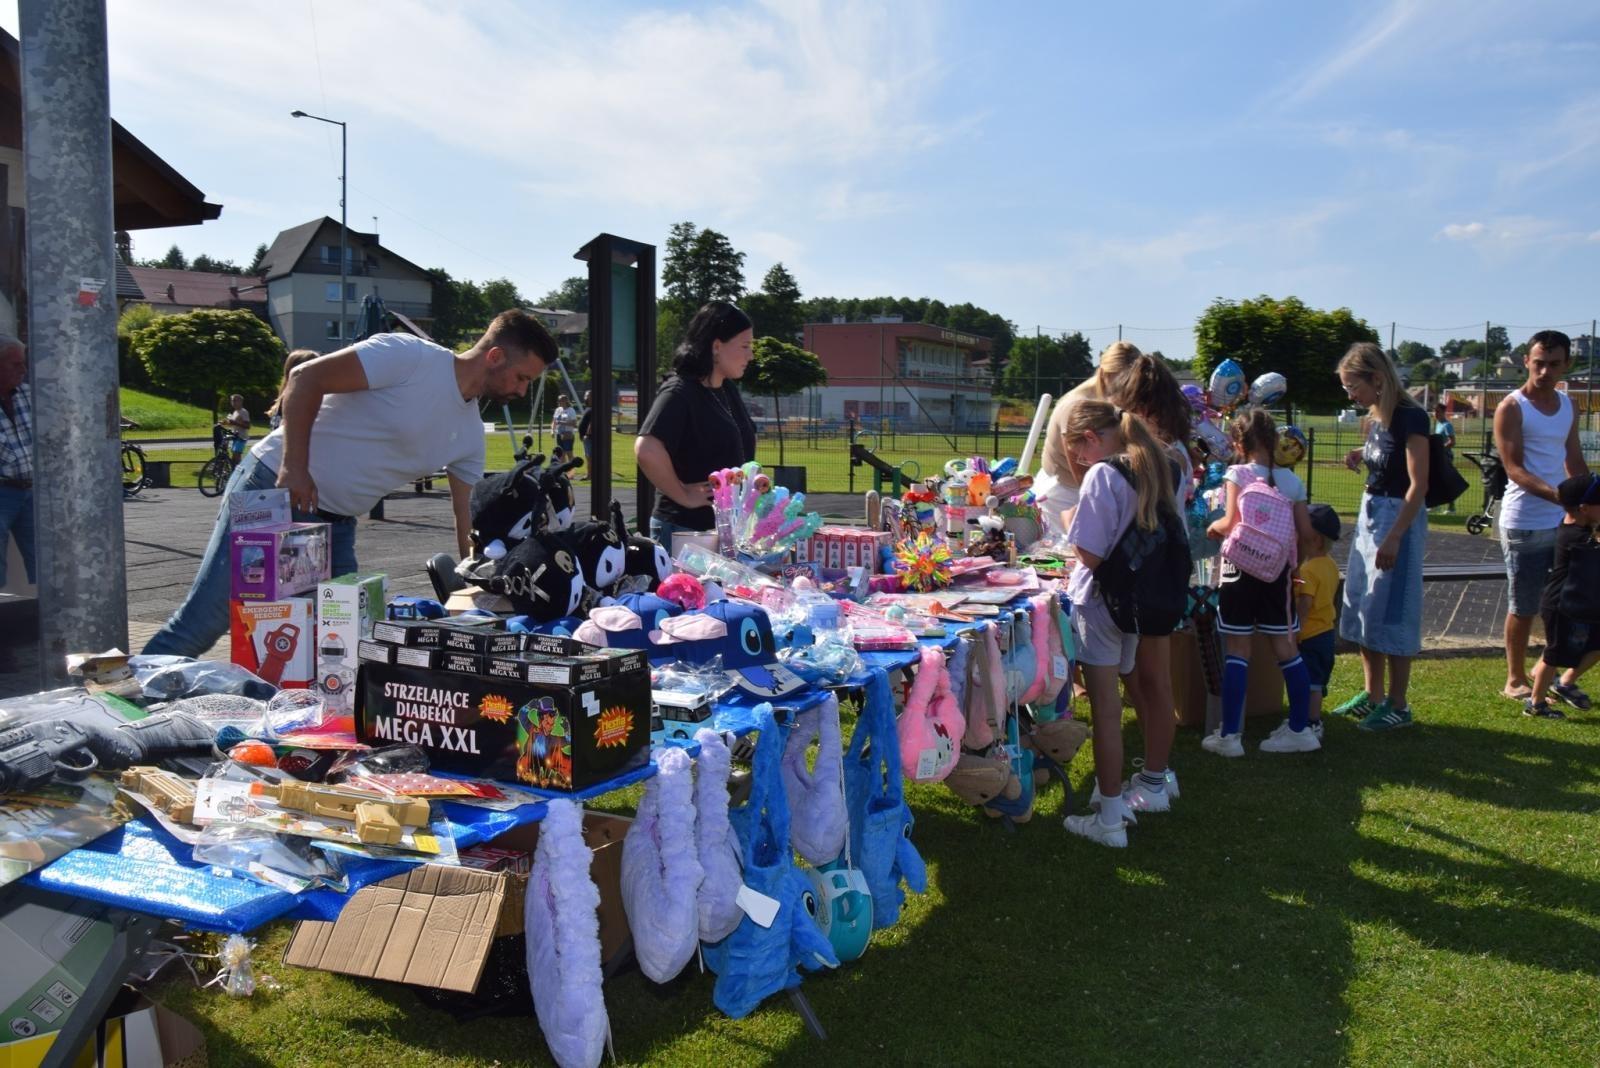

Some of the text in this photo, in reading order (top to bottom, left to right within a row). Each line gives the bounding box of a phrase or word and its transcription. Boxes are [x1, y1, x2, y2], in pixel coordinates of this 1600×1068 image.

[242, 606, 288, 614] EMERGENCY
[447, 640, 463, 649] MEGA
[534, 644, 550, 653] MEGA
[384, 682, 469, 709] STRZELAJĄCE
[396, 702, 455, 724] DIABEŁKI
[375, 714, 481, 755] MEGA XXL
